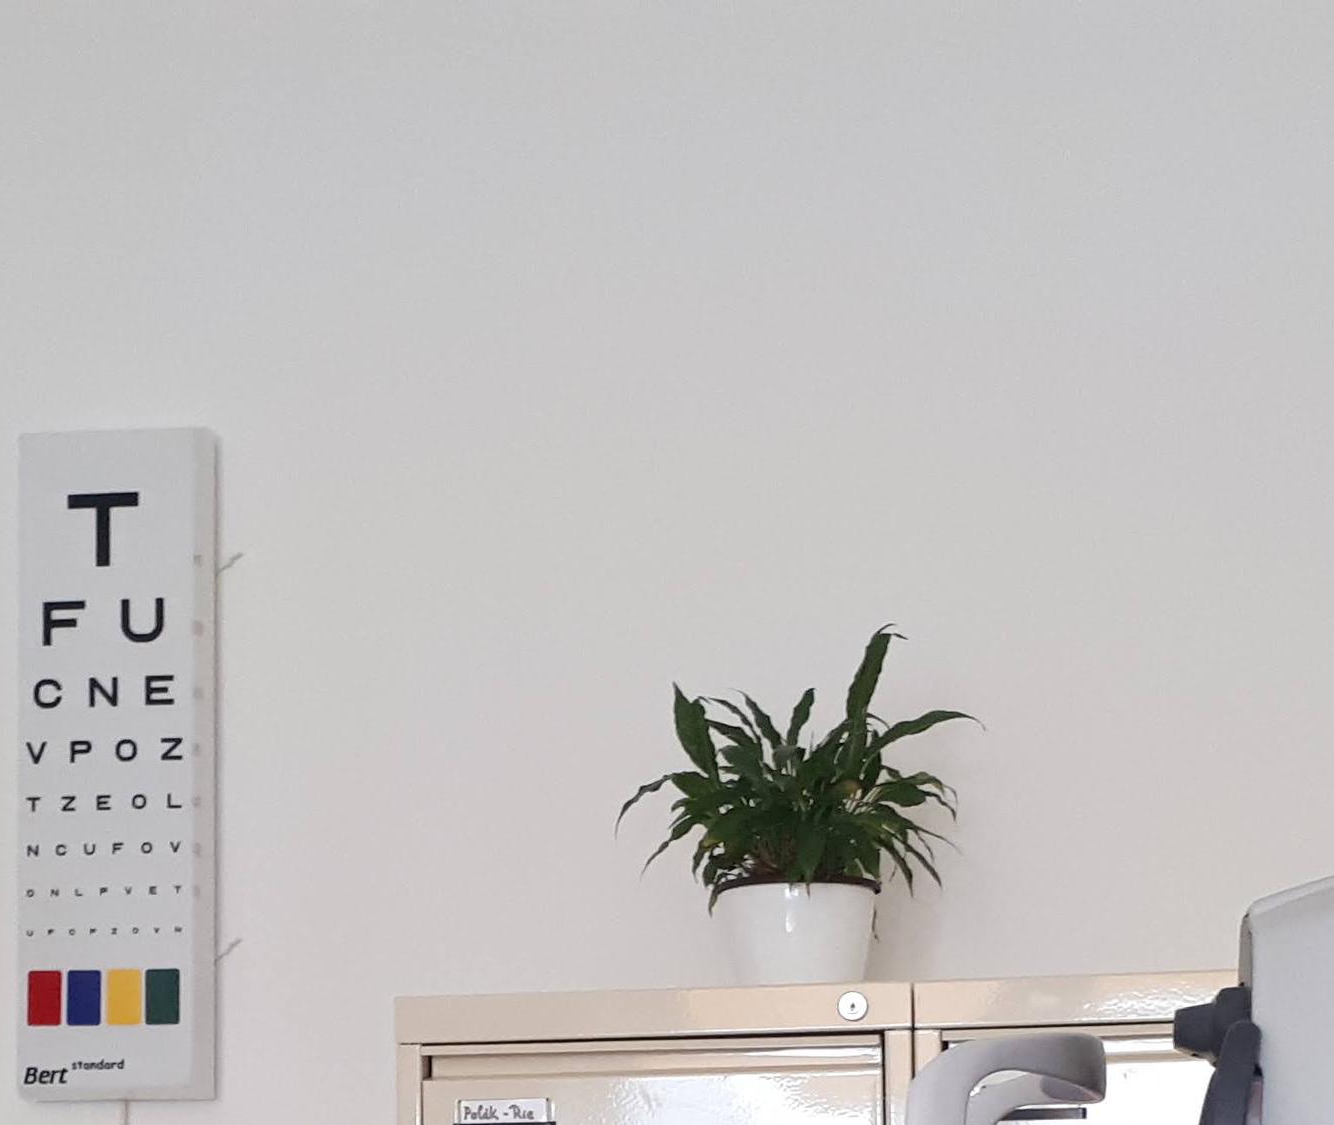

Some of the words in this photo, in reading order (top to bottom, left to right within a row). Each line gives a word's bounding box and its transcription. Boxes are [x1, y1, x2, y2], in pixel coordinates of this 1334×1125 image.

[67, 491, 140, 567] T
[42, 600, 87, 646] F
[120, 597, 165, 643] U
[33, 679, 63, 709] C
[88, 676, 119, 708] N
[144, 675, 175, 706] E
[23, 1066, 69, 1085] Bert
[71, 1058, 125, 1071] standard
